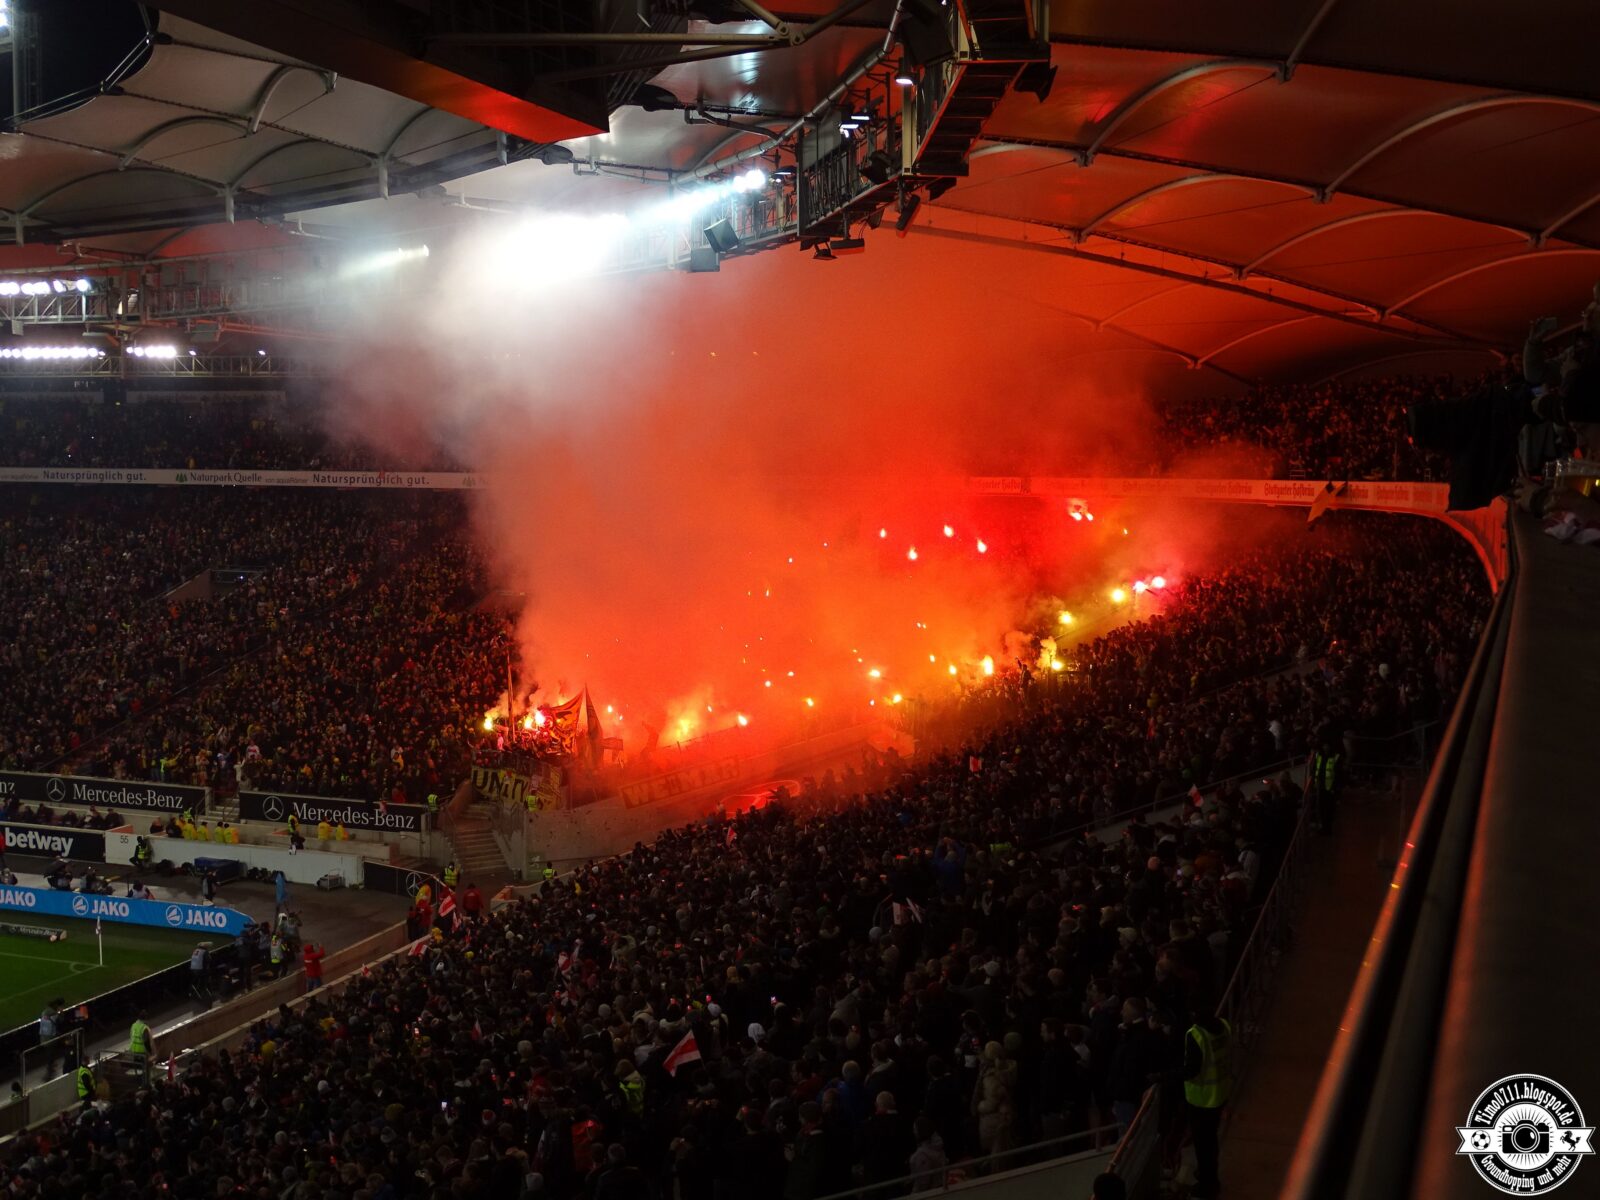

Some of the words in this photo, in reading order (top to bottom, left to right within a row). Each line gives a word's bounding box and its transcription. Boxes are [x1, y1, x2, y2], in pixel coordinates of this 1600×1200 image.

[43, 470, 124, 483] Natursprünglich
[127, 472, 147, 483] gut.
[190, 473, 233, 484] Naturpark
[234, 473, 262, 483] Quelle
[312, 473, 403, 487] Natursprünglich
[407, 476, 430, 487] gut.
[73, 783, 184, 810] Mercedes-Benz
[292, 801, 415, 830] Mercedes-Benz
[4, 827, 74, 858] betway
[0, 888, 37, 907] JAKO
[91, 901, 130, 917] JAKO
[185, 909, 228, 928] JAKO
